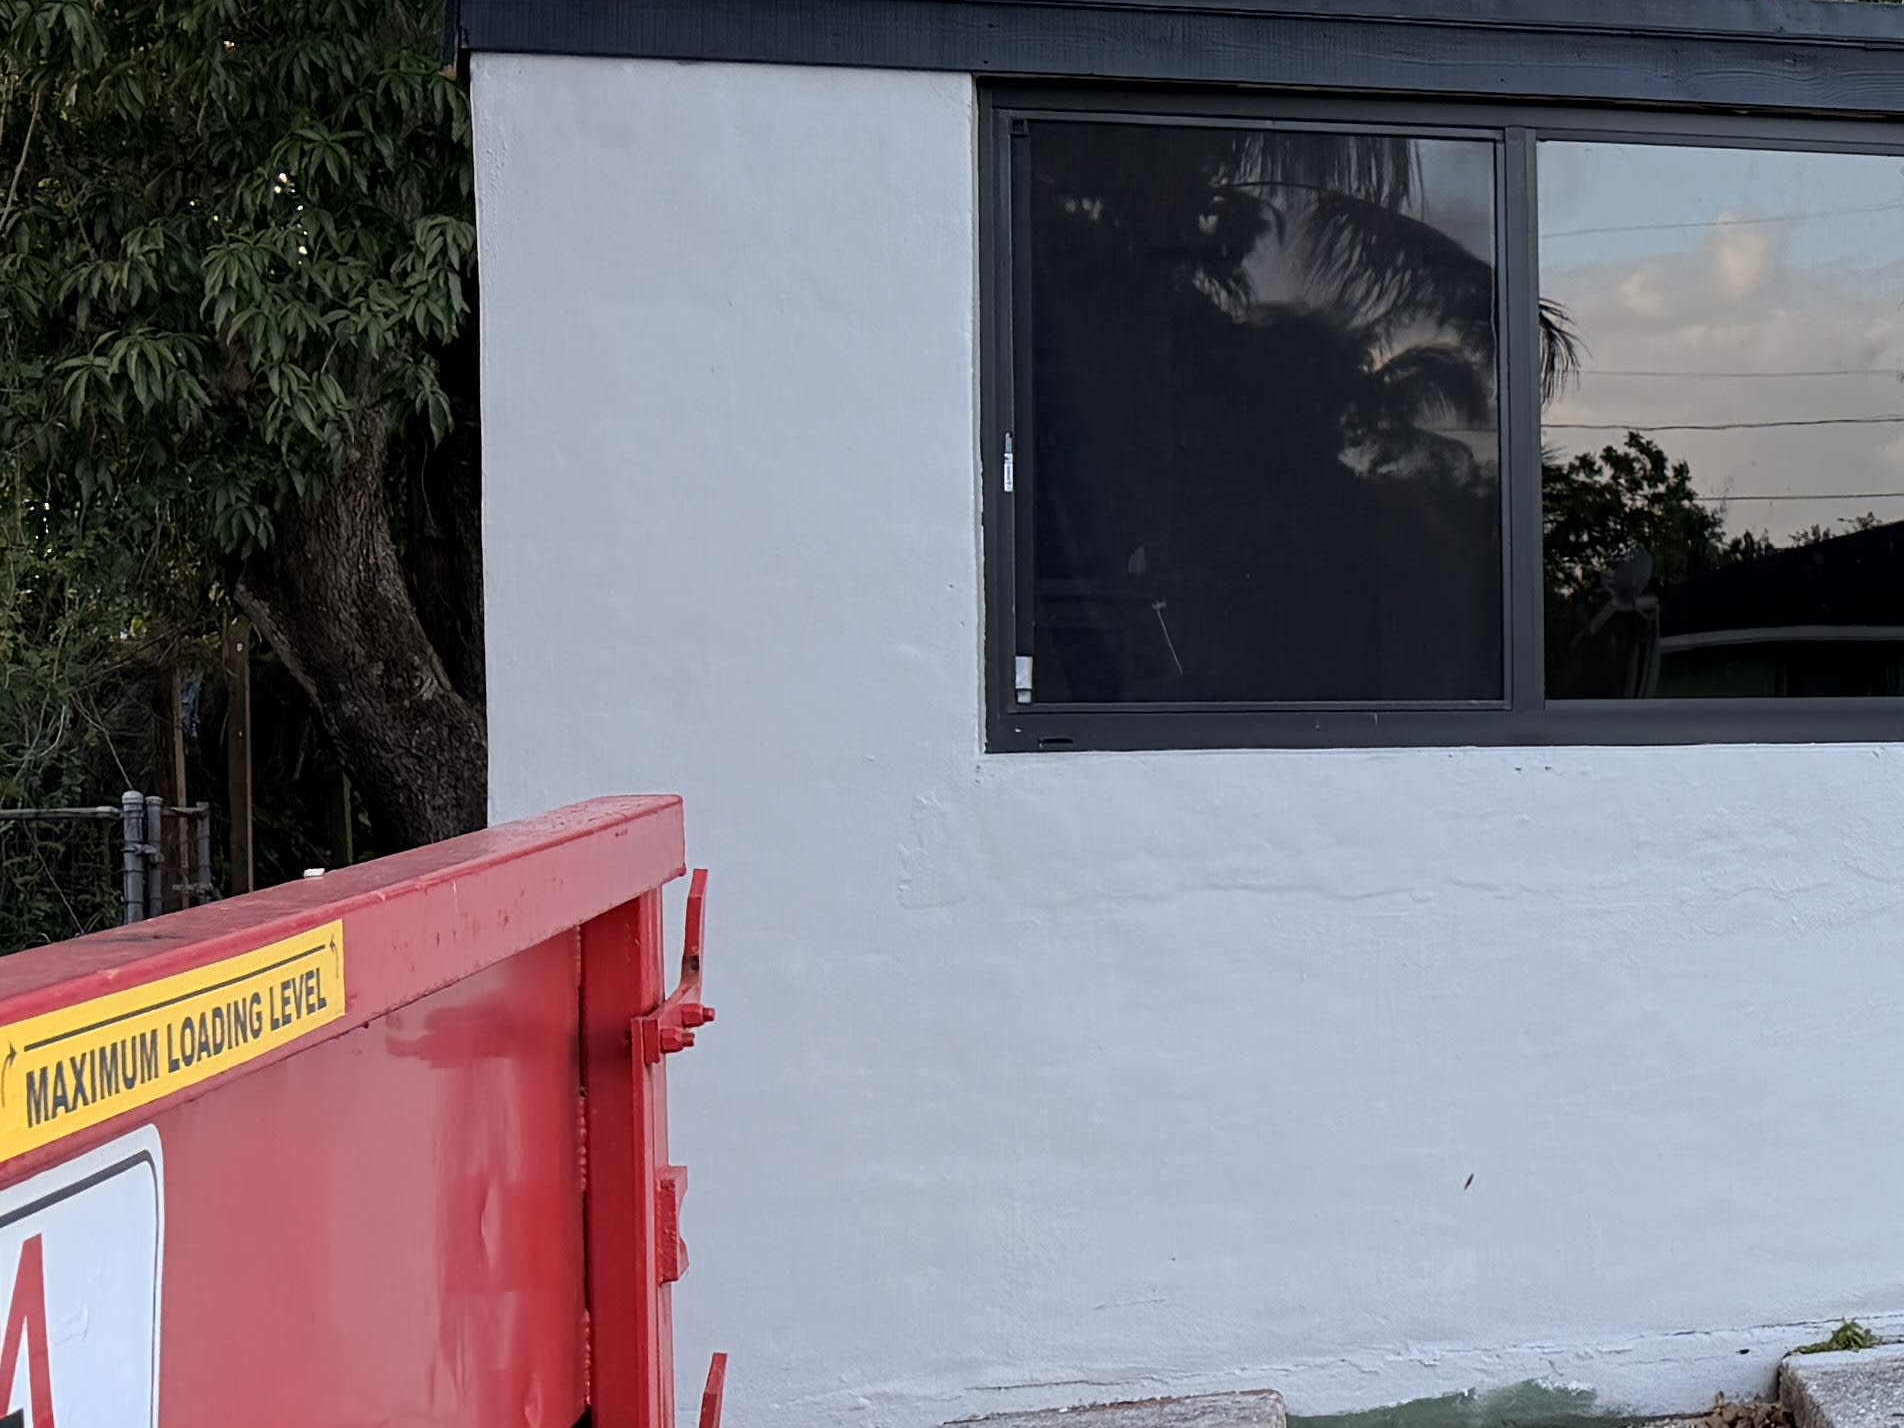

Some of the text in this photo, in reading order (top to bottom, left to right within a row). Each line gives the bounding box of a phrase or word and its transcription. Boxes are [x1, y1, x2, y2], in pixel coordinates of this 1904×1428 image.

[26, 967, 327, 1128] MAXIMUM LOADING LEVEL
